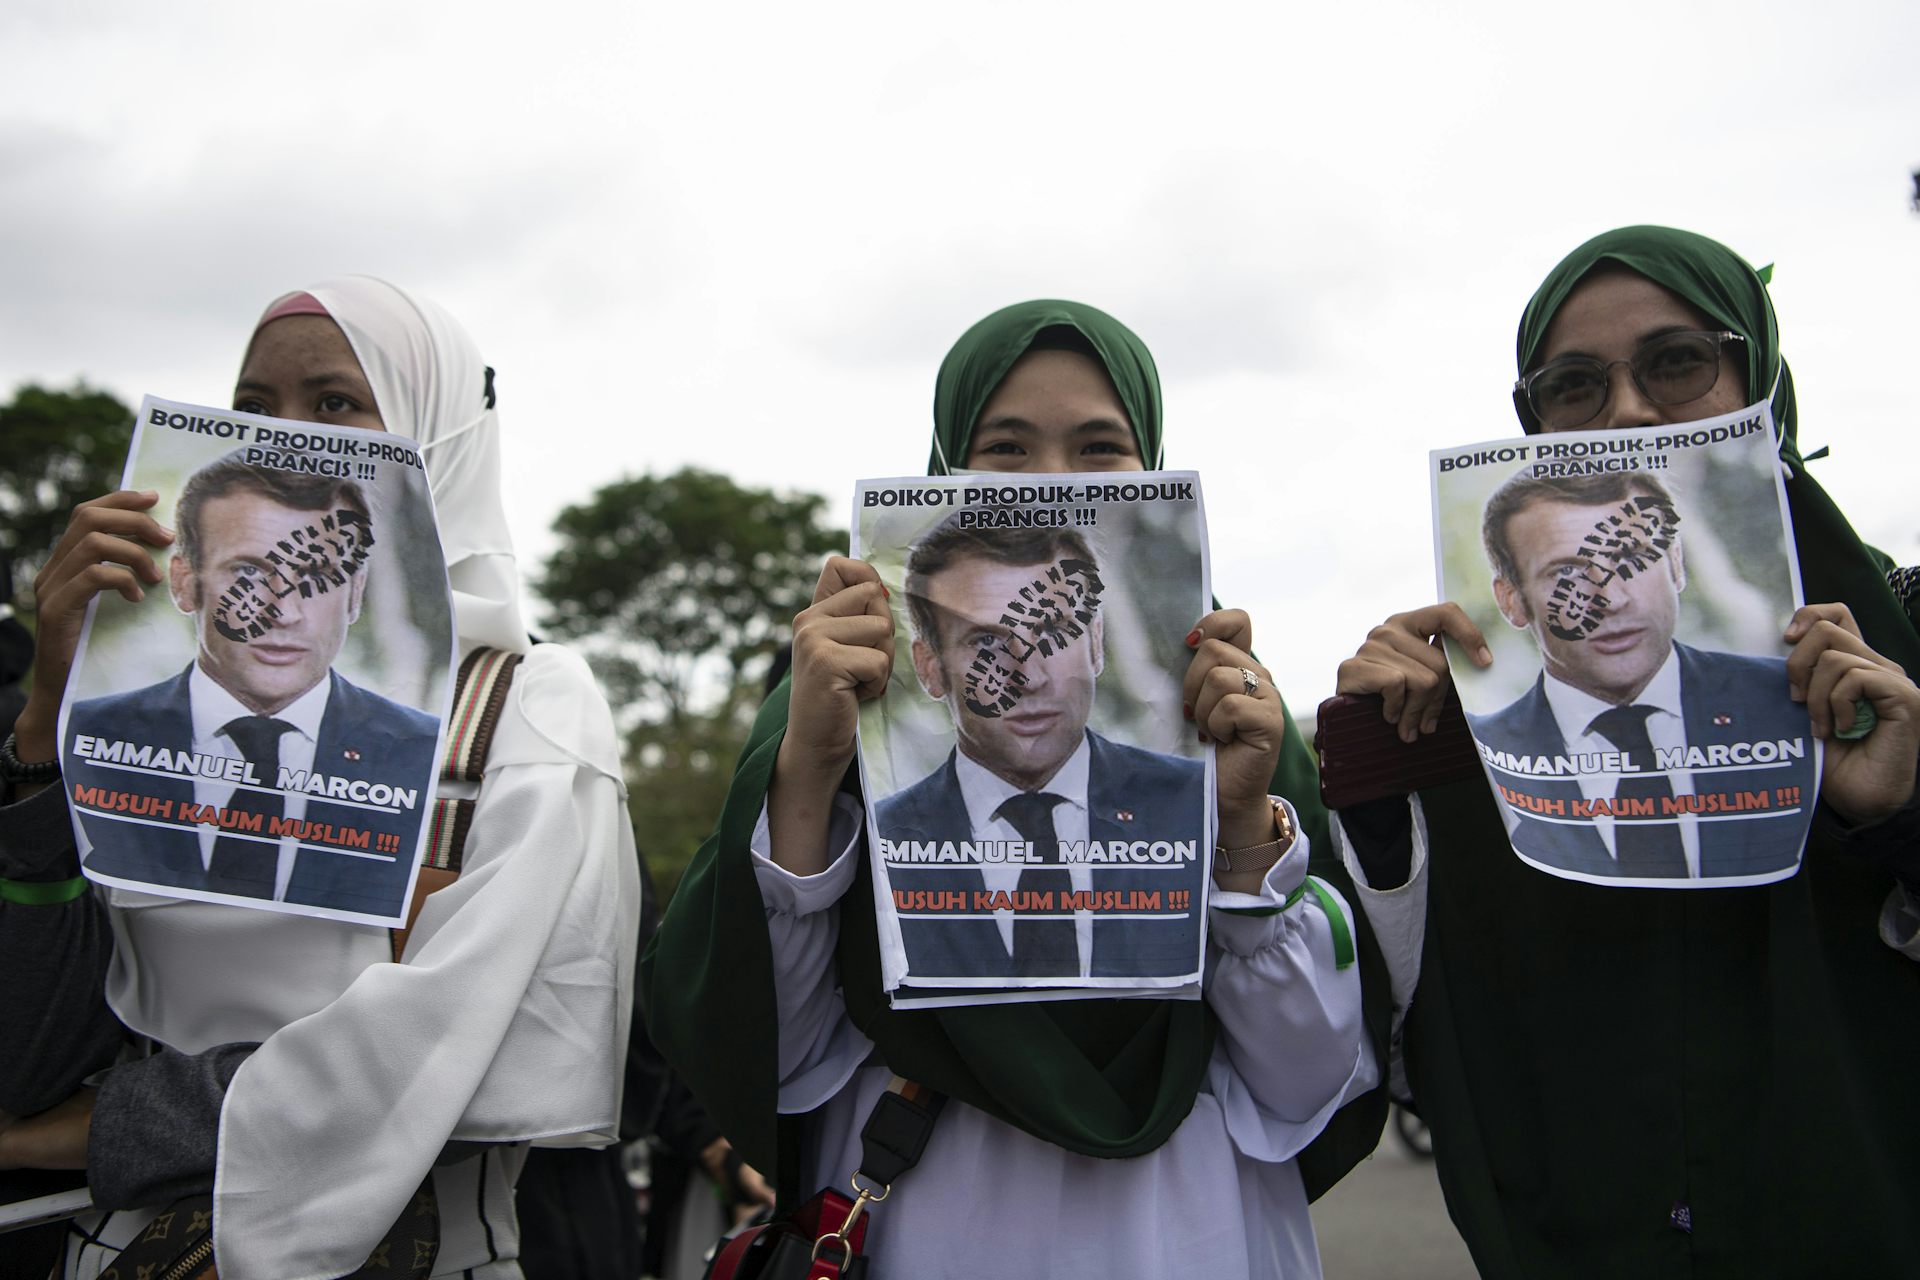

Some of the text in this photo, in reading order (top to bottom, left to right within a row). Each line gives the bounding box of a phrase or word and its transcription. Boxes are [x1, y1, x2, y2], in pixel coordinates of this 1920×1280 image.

[149, 409, 425, 472] BOIKOT PRODUK-PRODU
[1439, 416, 1763, 472] BOIKOT PRODUK-PRODUK
[245, 450, 376, 481] PRANCIS !!!
[1533, 455, 1668, 478] PRANCIS !!!
[863, 483, 1194, 507] BOIKOT PRODUK-PRODUK
[959, 508, 1097, 528] PRANCIS !!!
[1655, 737, 1804, 769] MARCON
[73, 734, 418, 810] EMMANUEL MARCON
[74, 783, 401, 853] MUSUH KAUM MUSLIM !!!
[1571, 796, 1655, 818] KAUM
[1661, 789, 1769, 813] MUSLIM
[1777, 787, 1800, 807] !!!
[1058, 840, 1197, 863] MARCON
[893, 890, 1190, 911] USUH KAUM MUSLIM !!!
